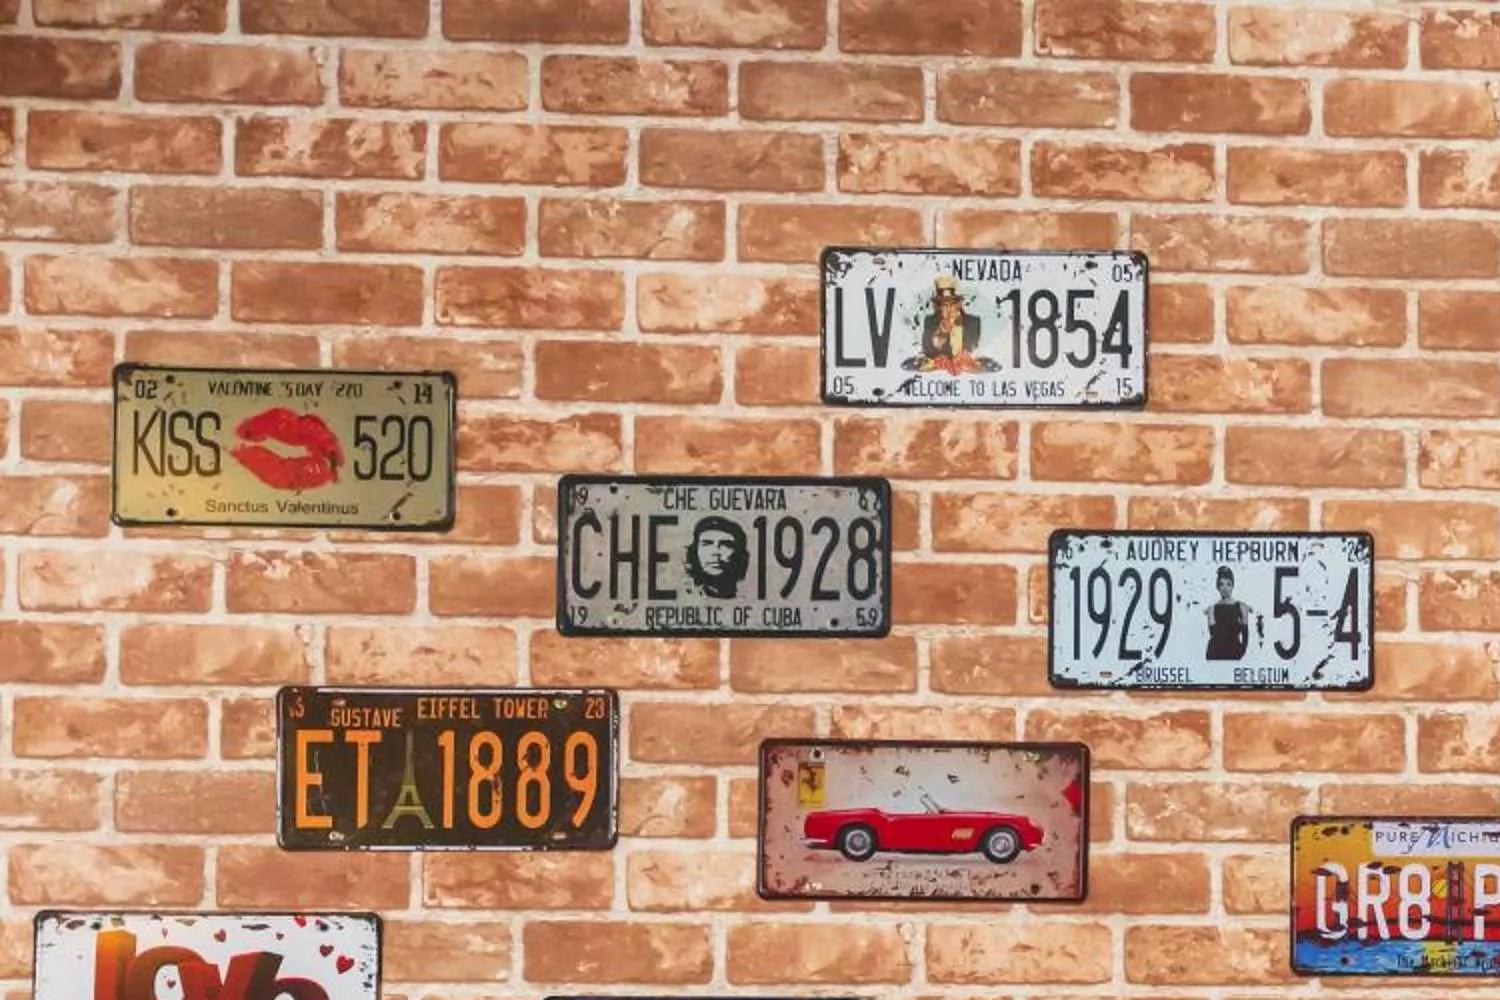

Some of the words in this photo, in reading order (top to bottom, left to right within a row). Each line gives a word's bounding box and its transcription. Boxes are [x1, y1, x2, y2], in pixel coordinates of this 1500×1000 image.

[952, 259, 1022, 281] NEVADA
[1112, 263, 1133, 282] 05
[835, 287, 896, 368] LV
[1005, 289, 1132, 369] 1854
[135, 380, 157, 399] 02
[833, 375, 855, 395] 05
[970, 380, 985, 397] TO
[993, 380, 1017, 397] LAS
[1025, 381, 1065, 397] VEGAS
[1116, 378, 1133, 397] 15
[132, 409, 222, 477] KISS
[353, 415, 434, 482] 520
[206, 499, 269, 513] Sanctus
[276, 500, 359, 515] Valentinus
[664, 488, 696, 511] CHE
[709, 489, 787, 511] GUEVARA
[572, 514, 678, 600] CHE
[754, 516, 878, 602] 1928
[1126, 540, 1199, 561] AUDREY
[1212, 540, 1298, 563] HEPBURN
[645, 607, 722, 627] REPUBLIC
[733, 607, 751, 626] OF
[763, 607, 801, 627] CUBA
[1070, 565, 1173, 660] 1929
[1136, 667, 1192, 683] BRUSSEL
[1234, 667, 1288, 683] BELGIUM
[330, 707, 403, 728] GUSTAVE
[417, 698, 481, 720] EIFFEL
[495, 698, 548, 720] TOWER
[585, 698, 605, 719] 23
[295, 729, 383, 829] ET
[438, 730, 598, 829] 1889
[1375, 831, 1420, 843] PURE
[1316, 863, 1431, 940] GR8
